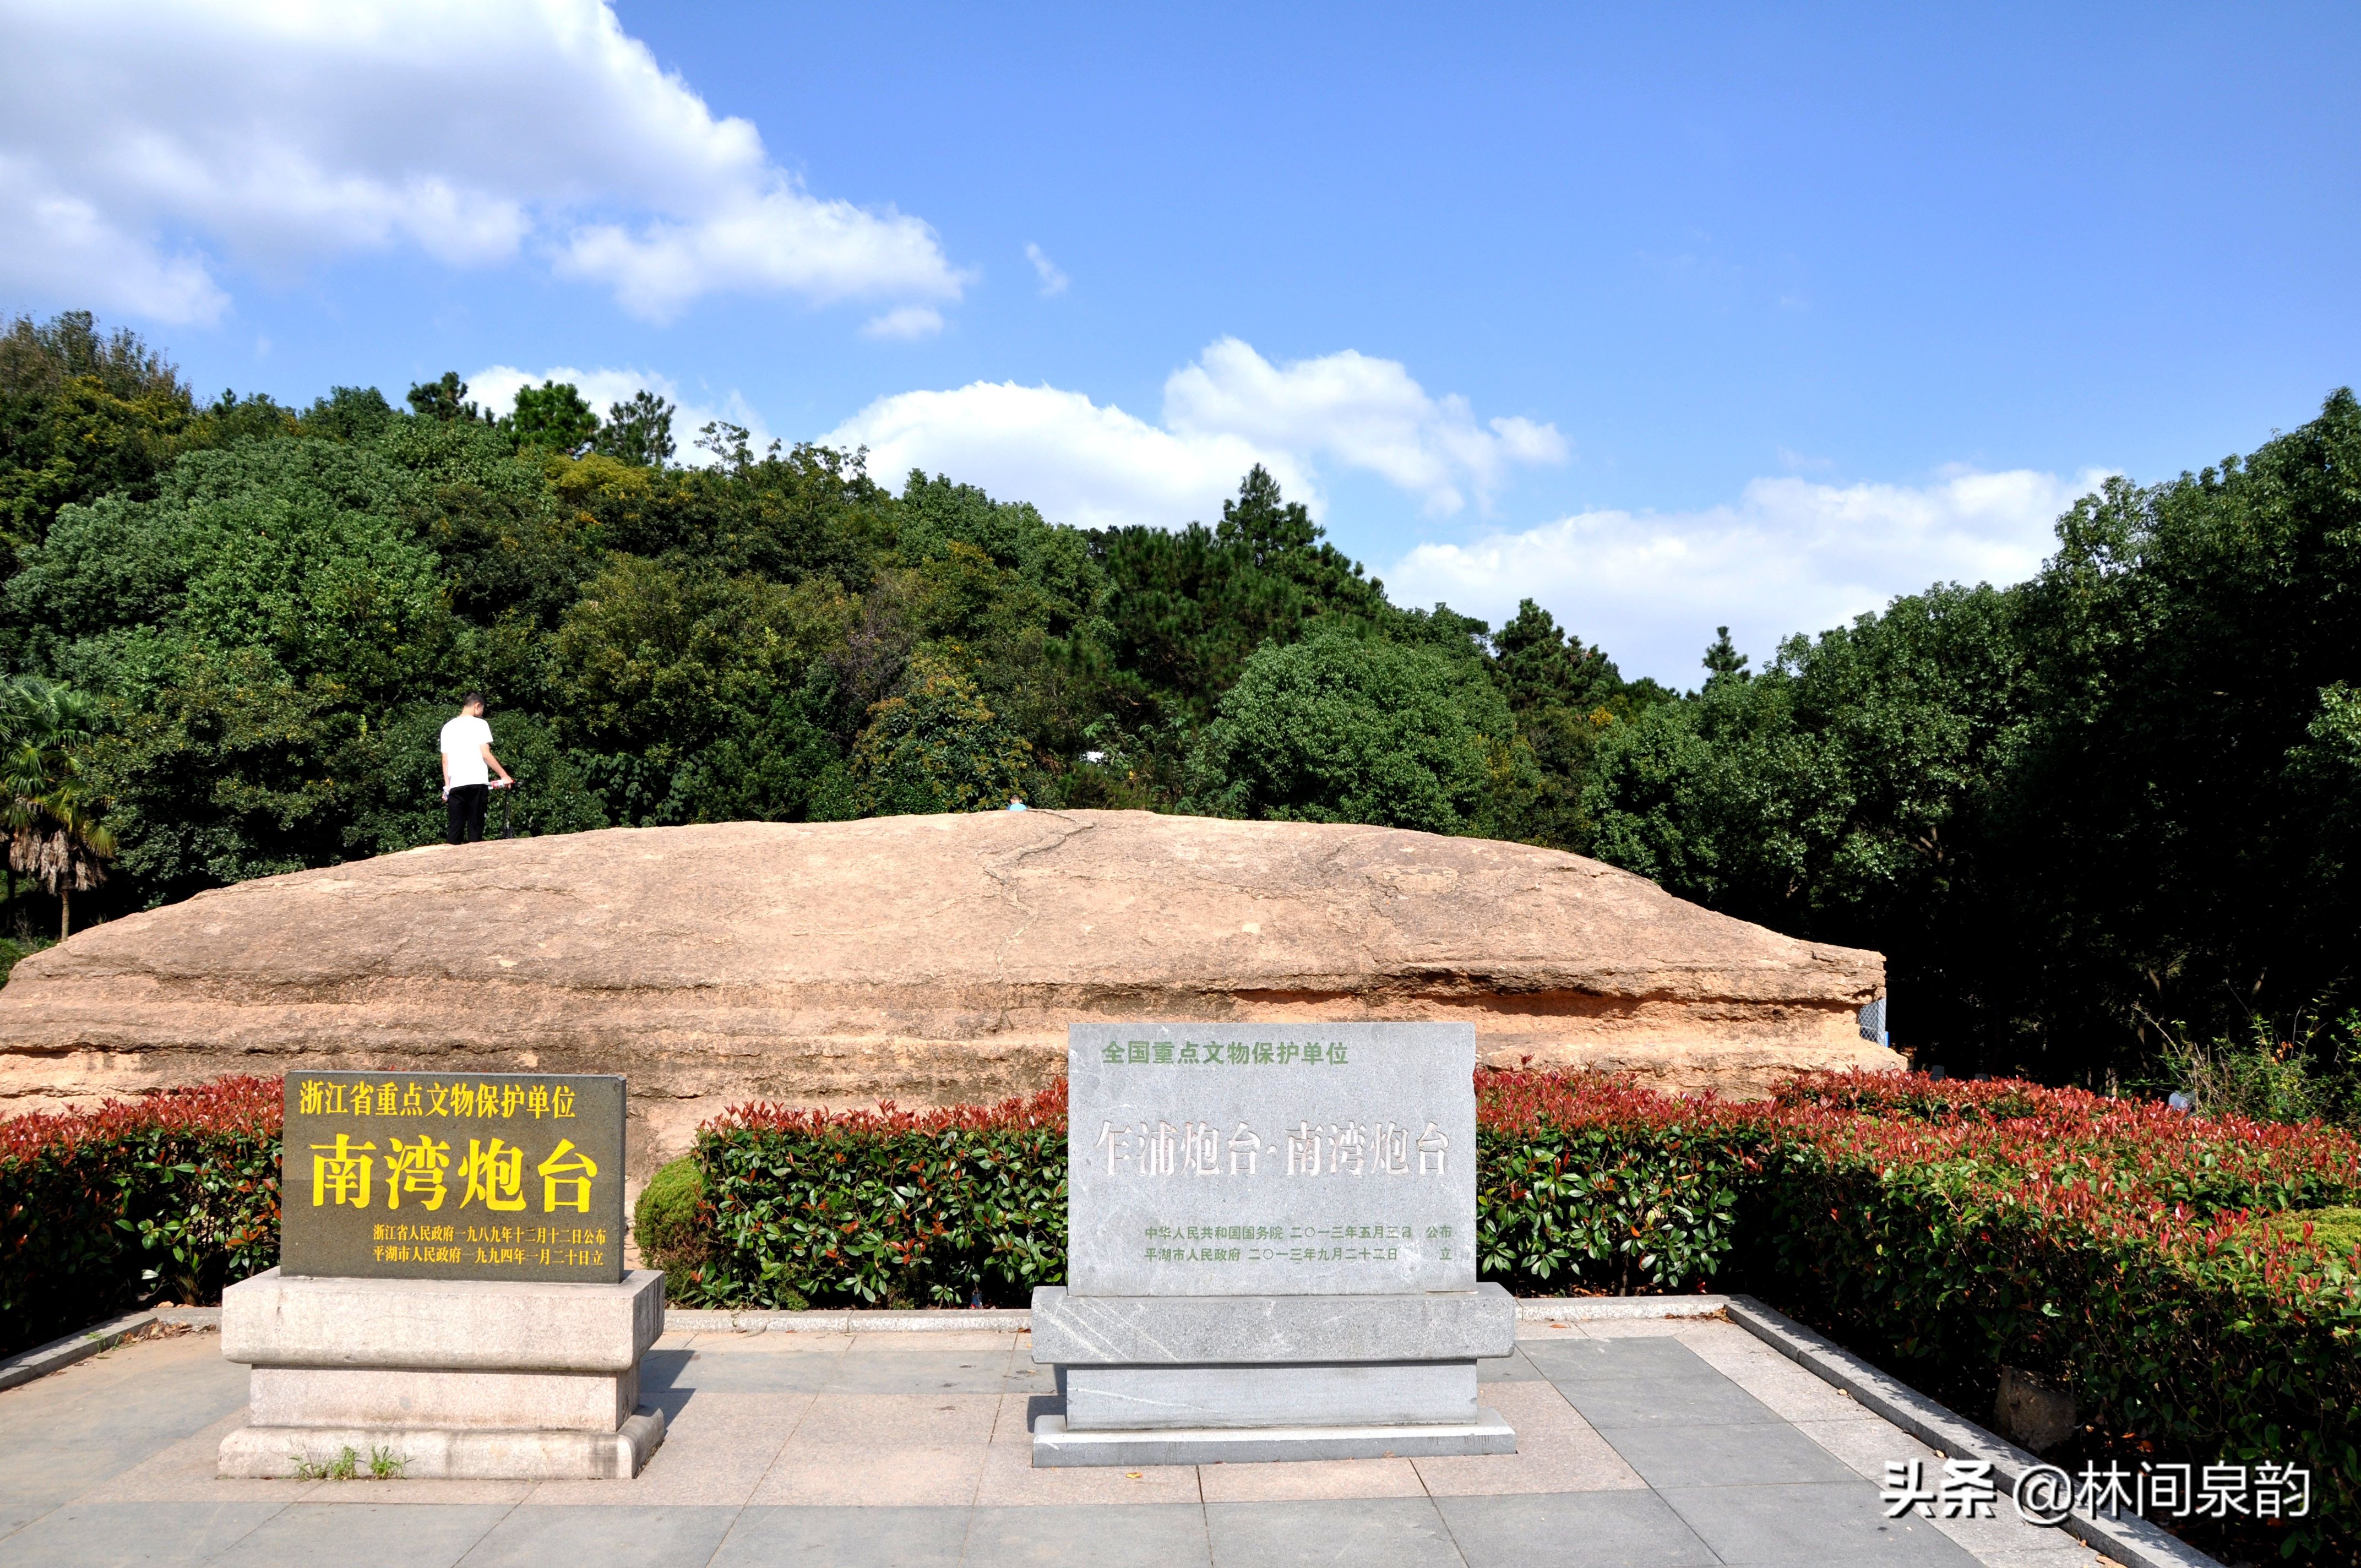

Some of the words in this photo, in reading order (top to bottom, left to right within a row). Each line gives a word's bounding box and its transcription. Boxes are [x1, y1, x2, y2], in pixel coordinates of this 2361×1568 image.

[1101, 1041, 1348, 1065] 全国重点文物保护单位
[300, 1079, 576, 1119] 浙江省重点文物保护单位
[310, 1133, 598, 1213] 南湾炮台
[373, 1223, 607, 1245] 浙江省人民政府一九八九年十二月十二日公布
[1145, 1226, 1283, 1240] 中华人民共和国国务院
[1426, 1224, 1452, 1239] 公布
[373, 1244, 604, 1266] 平湖市人民政府一九九四年一月二十日立
[1145, 1247, 1241, 1262] 平湖市人民政府
[1439, 1246, 1452, 1260] 立
